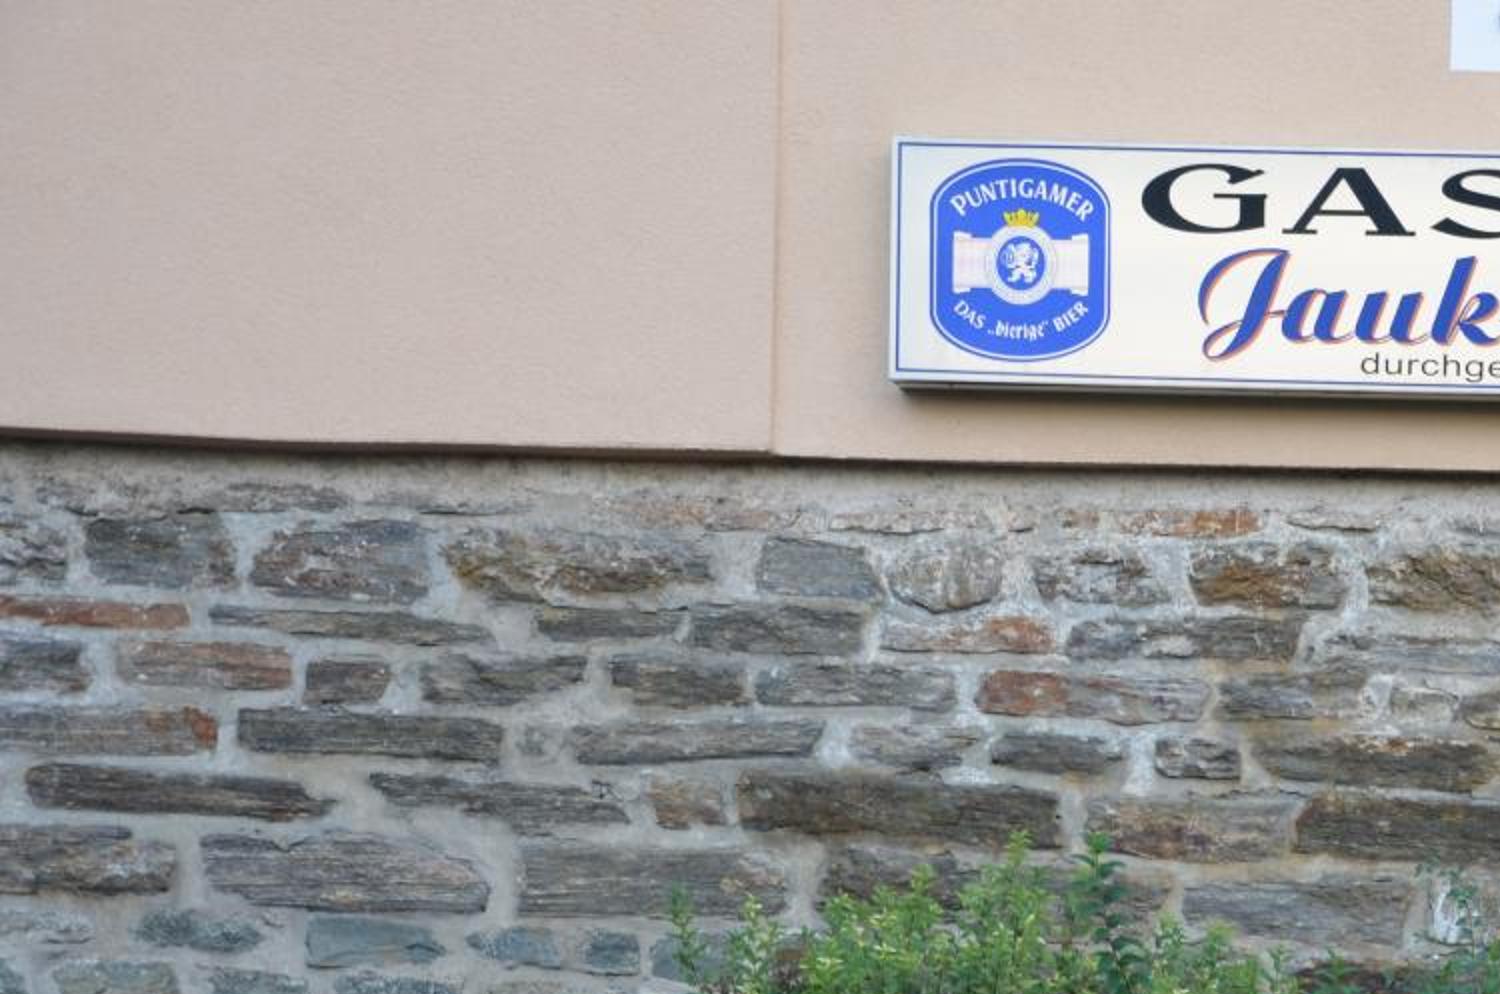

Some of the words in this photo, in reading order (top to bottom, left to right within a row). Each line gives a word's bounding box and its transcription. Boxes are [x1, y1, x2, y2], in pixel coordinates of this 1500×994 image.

[950, 178, 1095, 223] PUNTIGAMER
[953, 299, 987, 330] DAS
[1052, 301, 1089, 333] BIER
